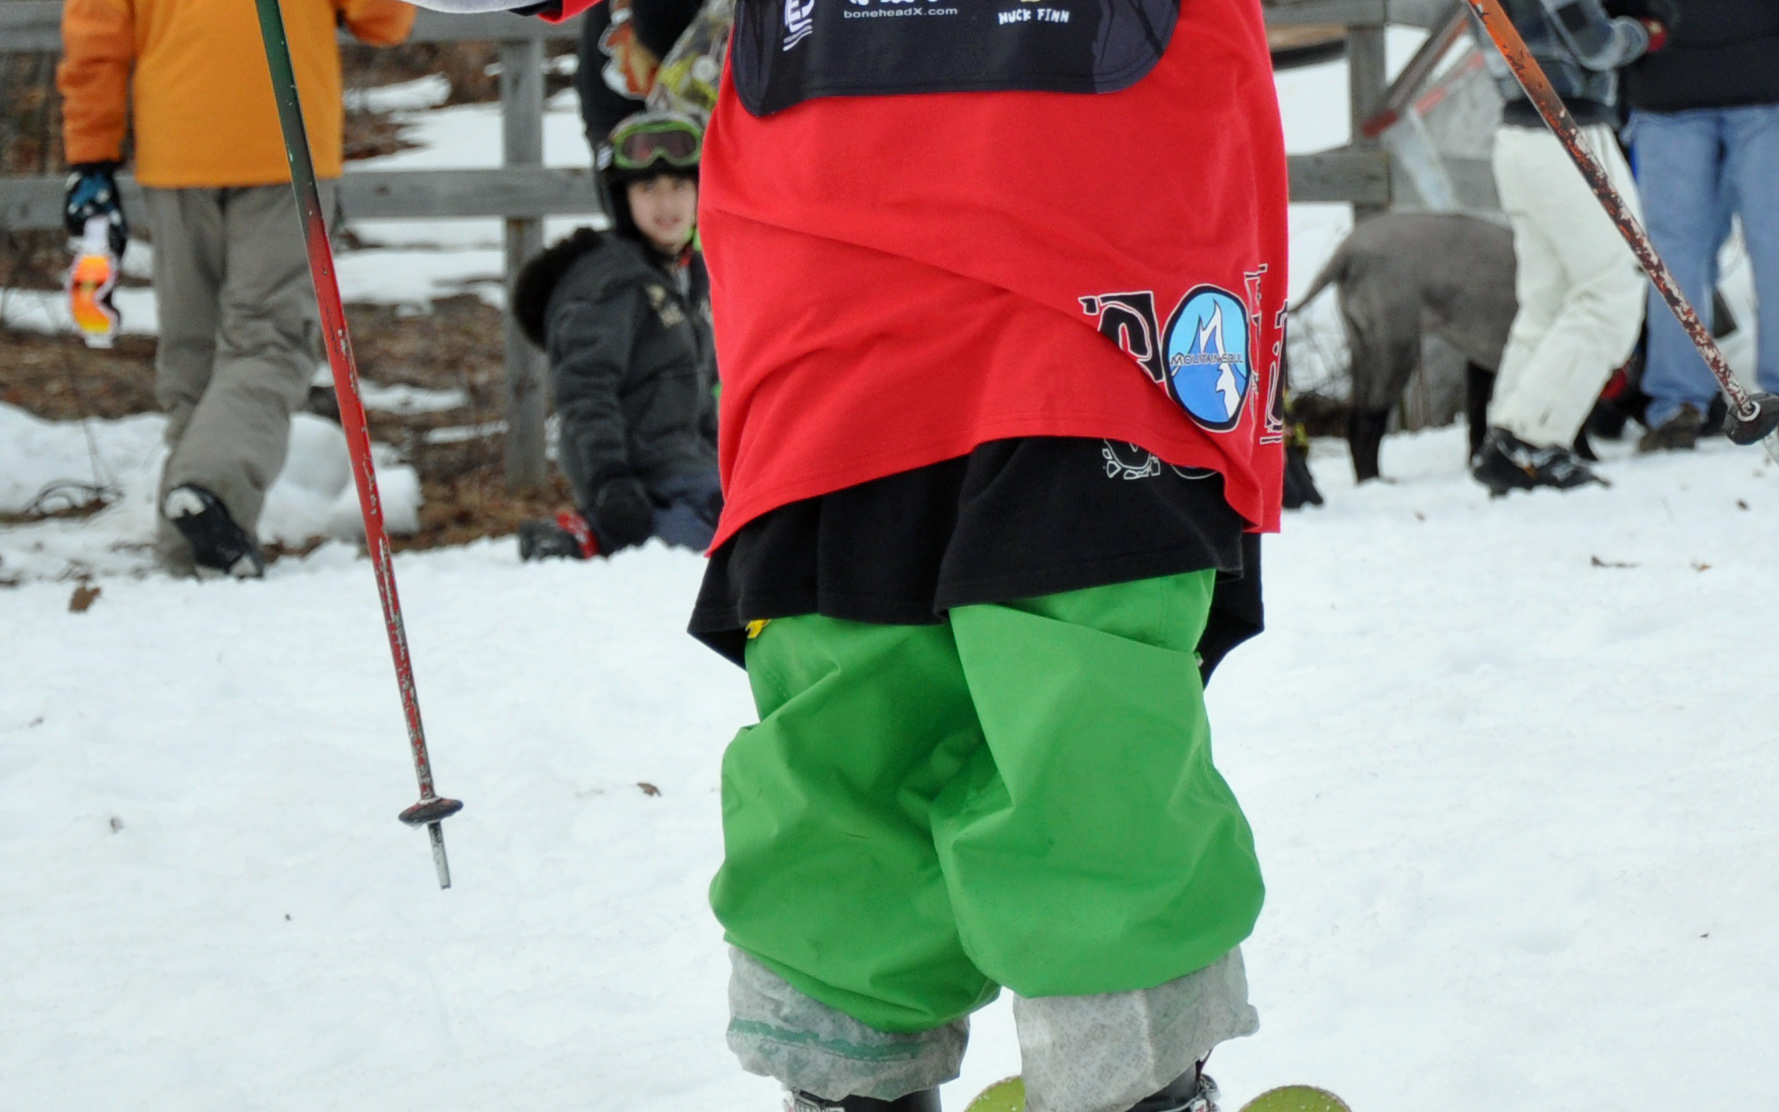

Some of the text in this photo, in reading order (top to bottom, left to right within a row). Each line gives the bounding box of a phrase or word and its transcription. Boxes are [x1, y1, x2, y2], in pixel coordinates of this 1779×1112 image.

[843, 7, 958, 19] boneheadX.com
[998, 8, 1070, 25] HUCK FINN
